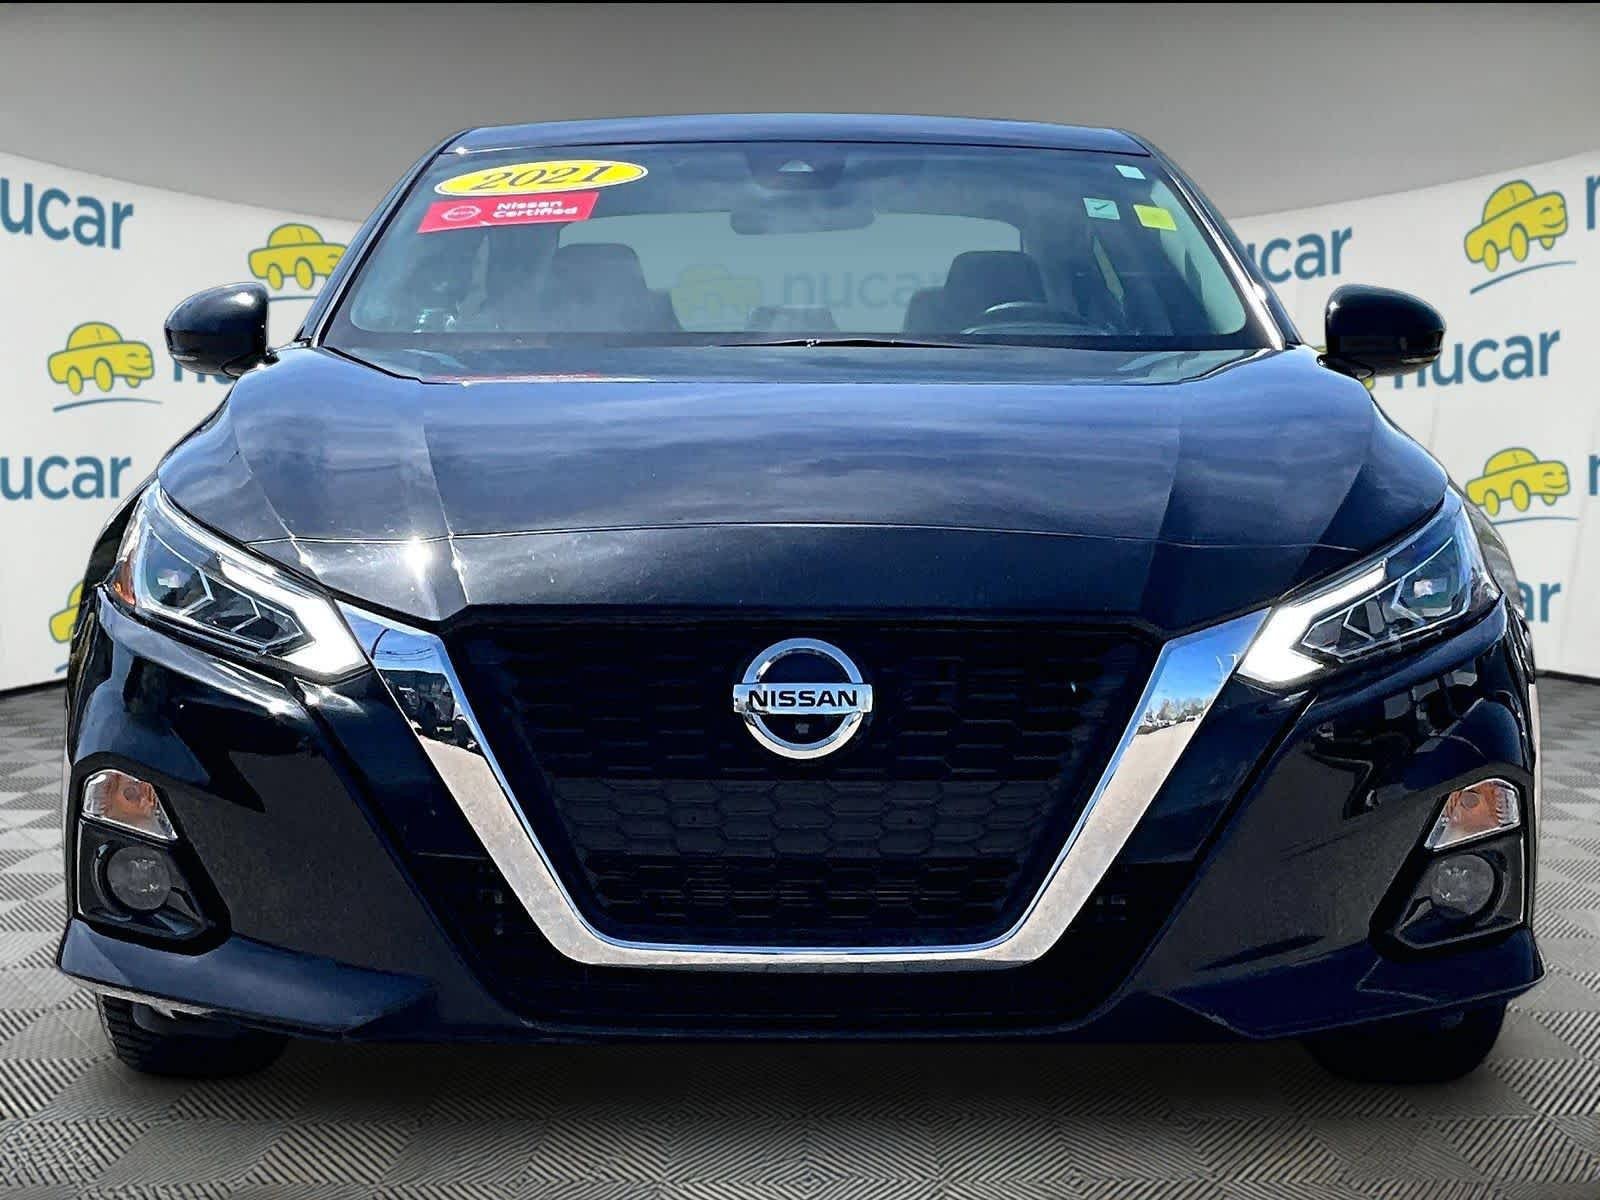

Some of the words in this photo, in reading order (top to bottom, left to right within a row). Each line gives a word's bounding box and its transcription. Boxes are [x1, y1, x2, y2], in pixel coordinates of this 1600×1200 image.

[472, 165, 614, 191] 2021
[0, 177, 134, 250] ucar
[492, 206, 579, 218] Certified
[496, 200, 563, 210] Nissan
[1246, 227, 1353, 284] car
[0, 455, 132, 501] ucar
[748, 690, 858, 707] NISSAN
